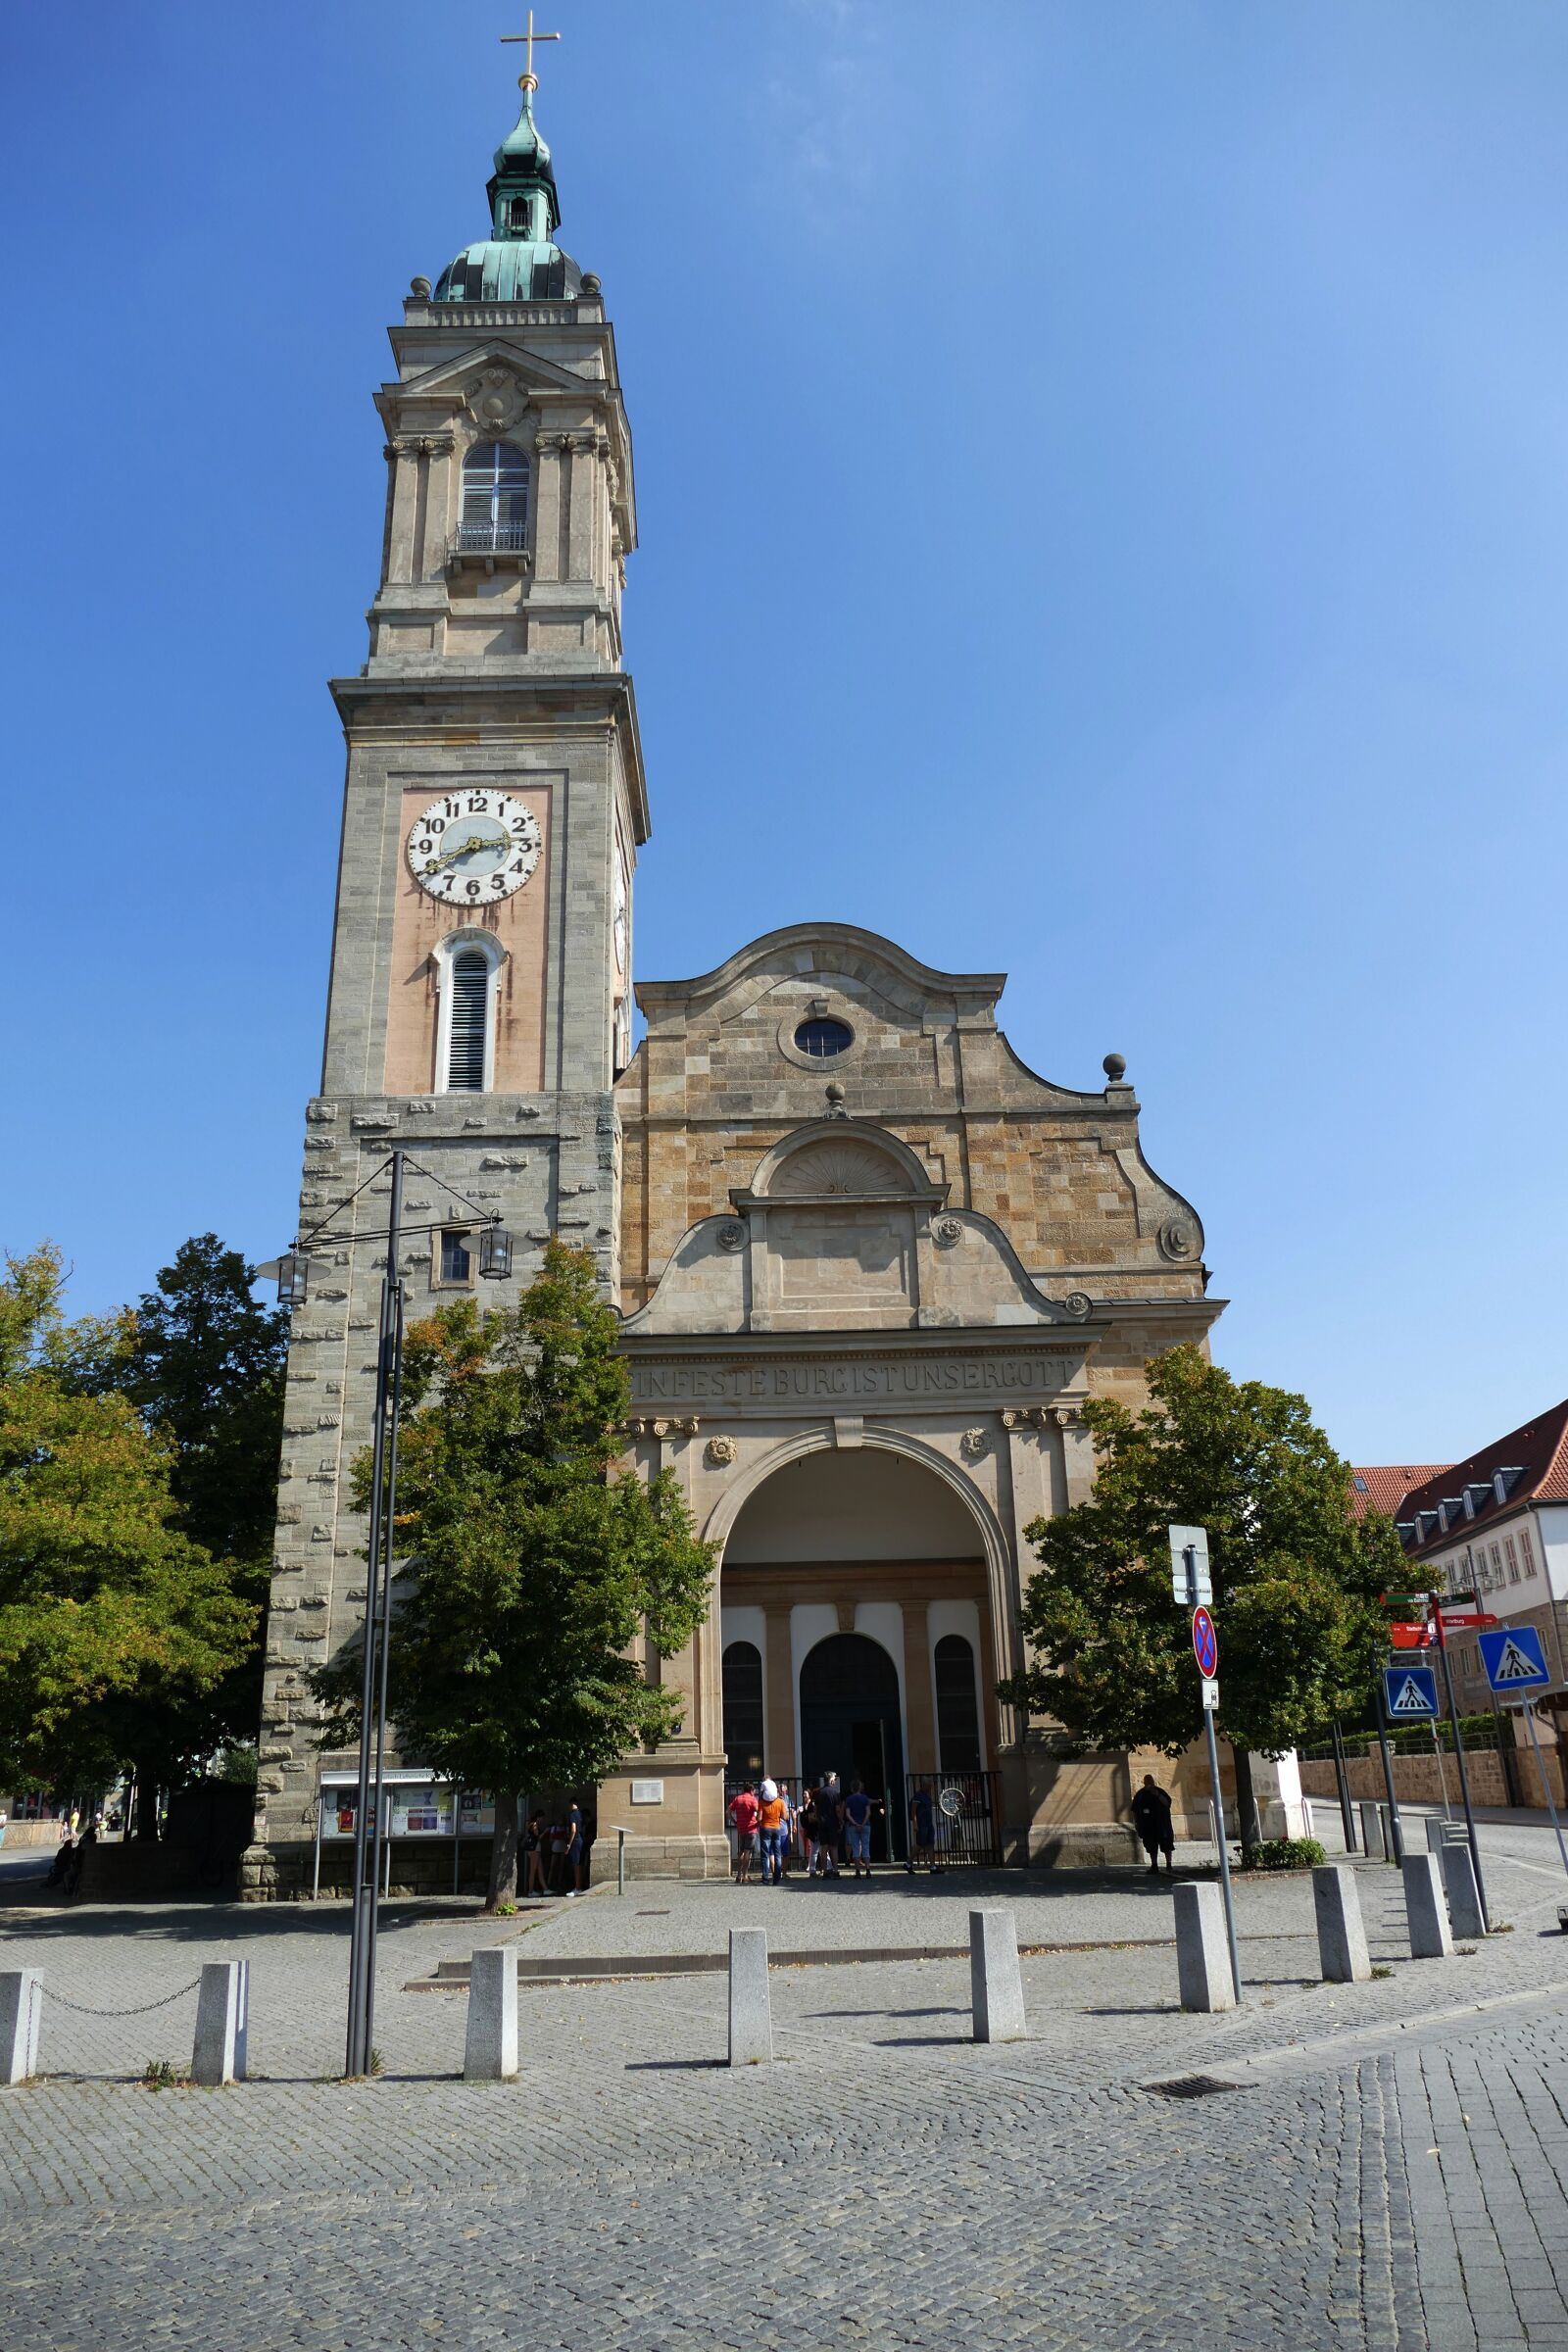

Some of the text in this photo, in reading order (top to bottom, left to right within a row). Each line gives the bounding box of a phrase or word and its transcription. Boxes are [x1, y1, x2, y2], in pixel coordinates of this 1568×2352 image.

[445, 803, 460, 817] 11
[467, 797, 488, 812] 12
[497, 802, 505, 817] 1
[425, 818, 445, 834] 10
[512, 817, 526, 832] 2
[418, 839, 432, 855] 9
[518, 837, 532, 853] 3
[509, 858, 523, 873] 4
[443, 874, 457, 891] 7
[466, 880, 480, 896] 6
[490, 873, 506, 890] 5
[628, 1360, 1075, 1397] IN FESTE BURG IST UNSER GOTT
